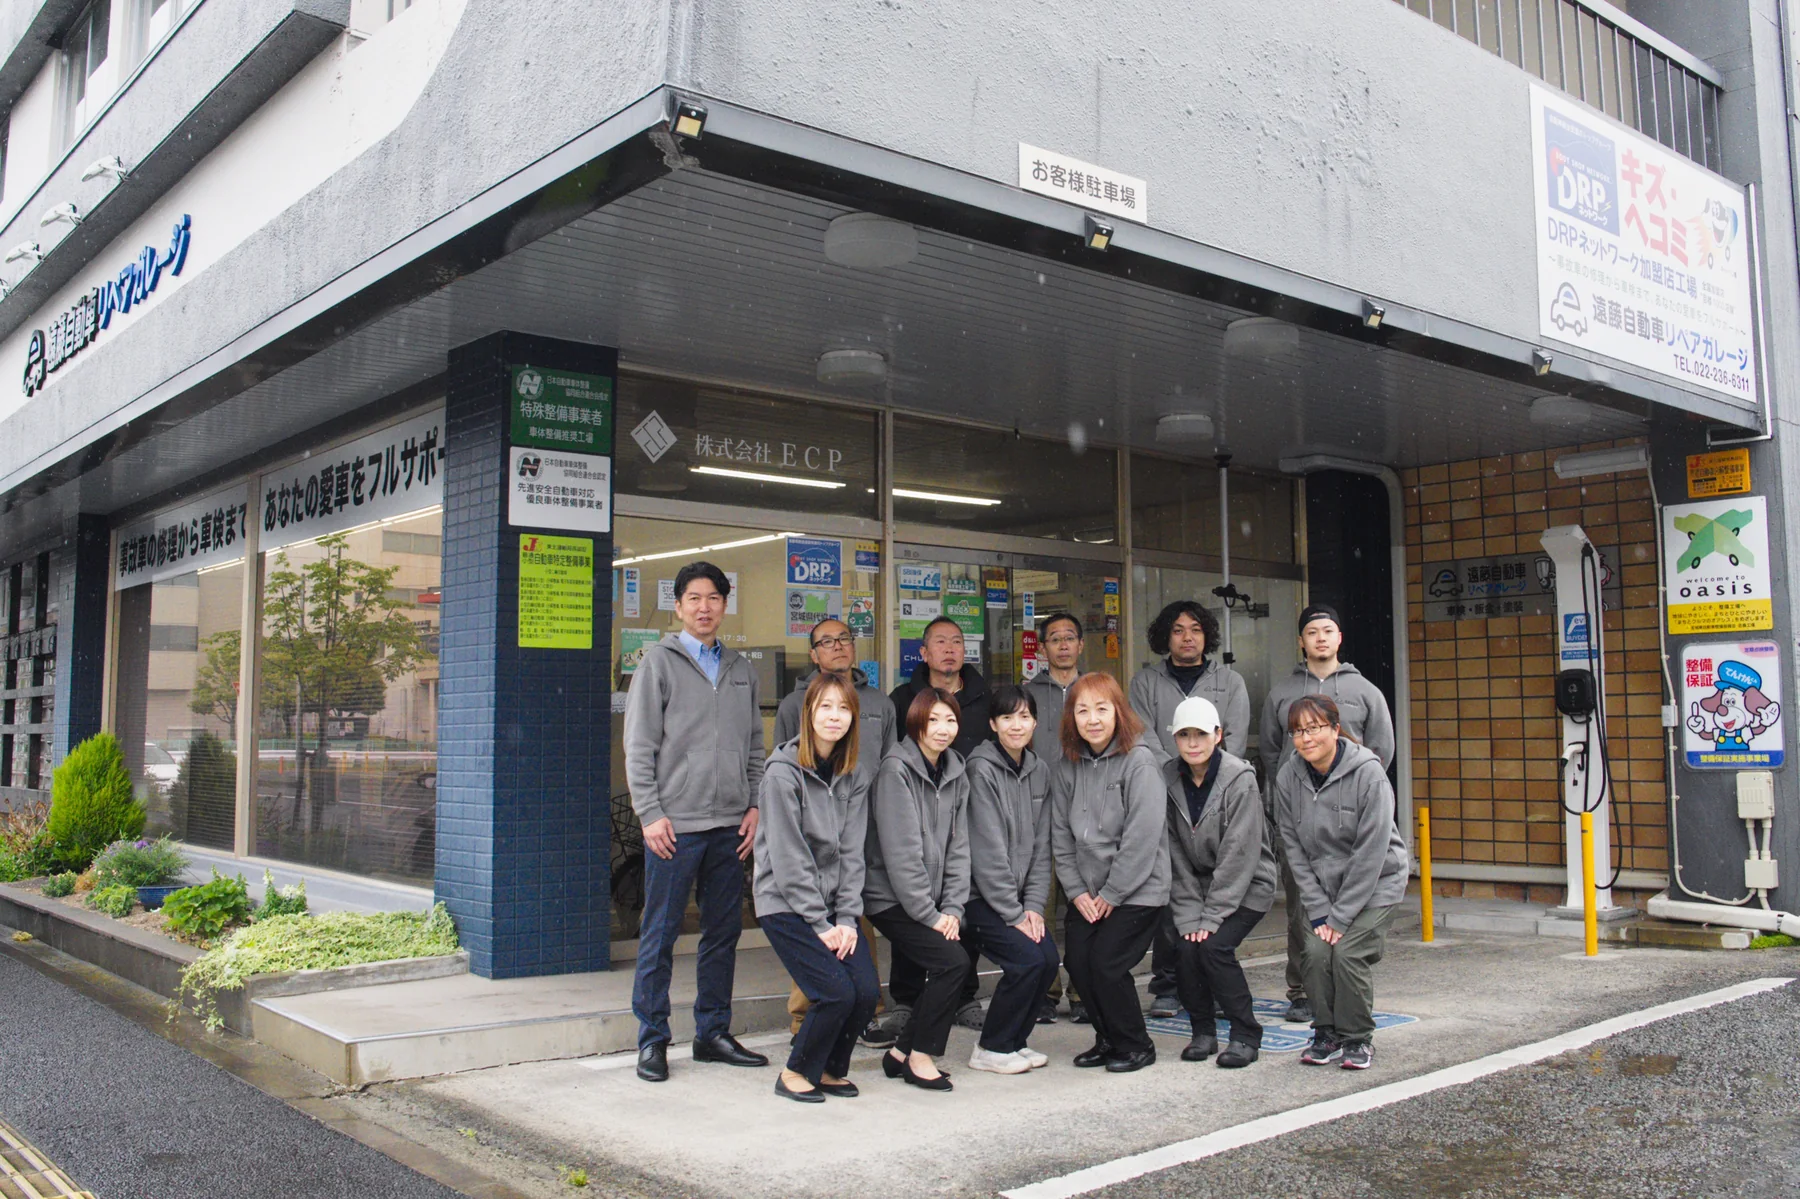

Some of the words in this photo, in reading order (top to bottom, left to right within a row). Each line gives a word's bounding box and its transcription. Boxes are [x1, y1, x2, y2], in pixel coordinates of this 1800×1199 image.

[1032, 159, 1136, 209] お客様駐車場
[1557, 165, 1606, 212] DRP
[1624, 202, 1689, 268] ヘコミ
[1547, 216, 1698, 300] DRPネットワーク加盟店工場
[1592, 293, 1748, 371] 遠藤自動車リペアガレージ
[1673, 353, 1750, 392] TEL.022-236-6311
[520, 400, 603, 426] 特殊整備事業者
[695, 433, 772, 464] 株式会社
[782, 442, 843, 472] ECP
[517, 482, 595, 499] 先進安全自動車対応
[526, 494, 603, 510] 優良車体整備事業者
[795, 561, 831, 581] DRP
[1467, 562, 1526, 584] 遠藤自動車
[1686, 575, 1730, 584] welcome
[1680, 580, 1753, 598] oasis
[1685, 657, 1713, 673] 整備
[1686, 673, 1714, 688] 保証
